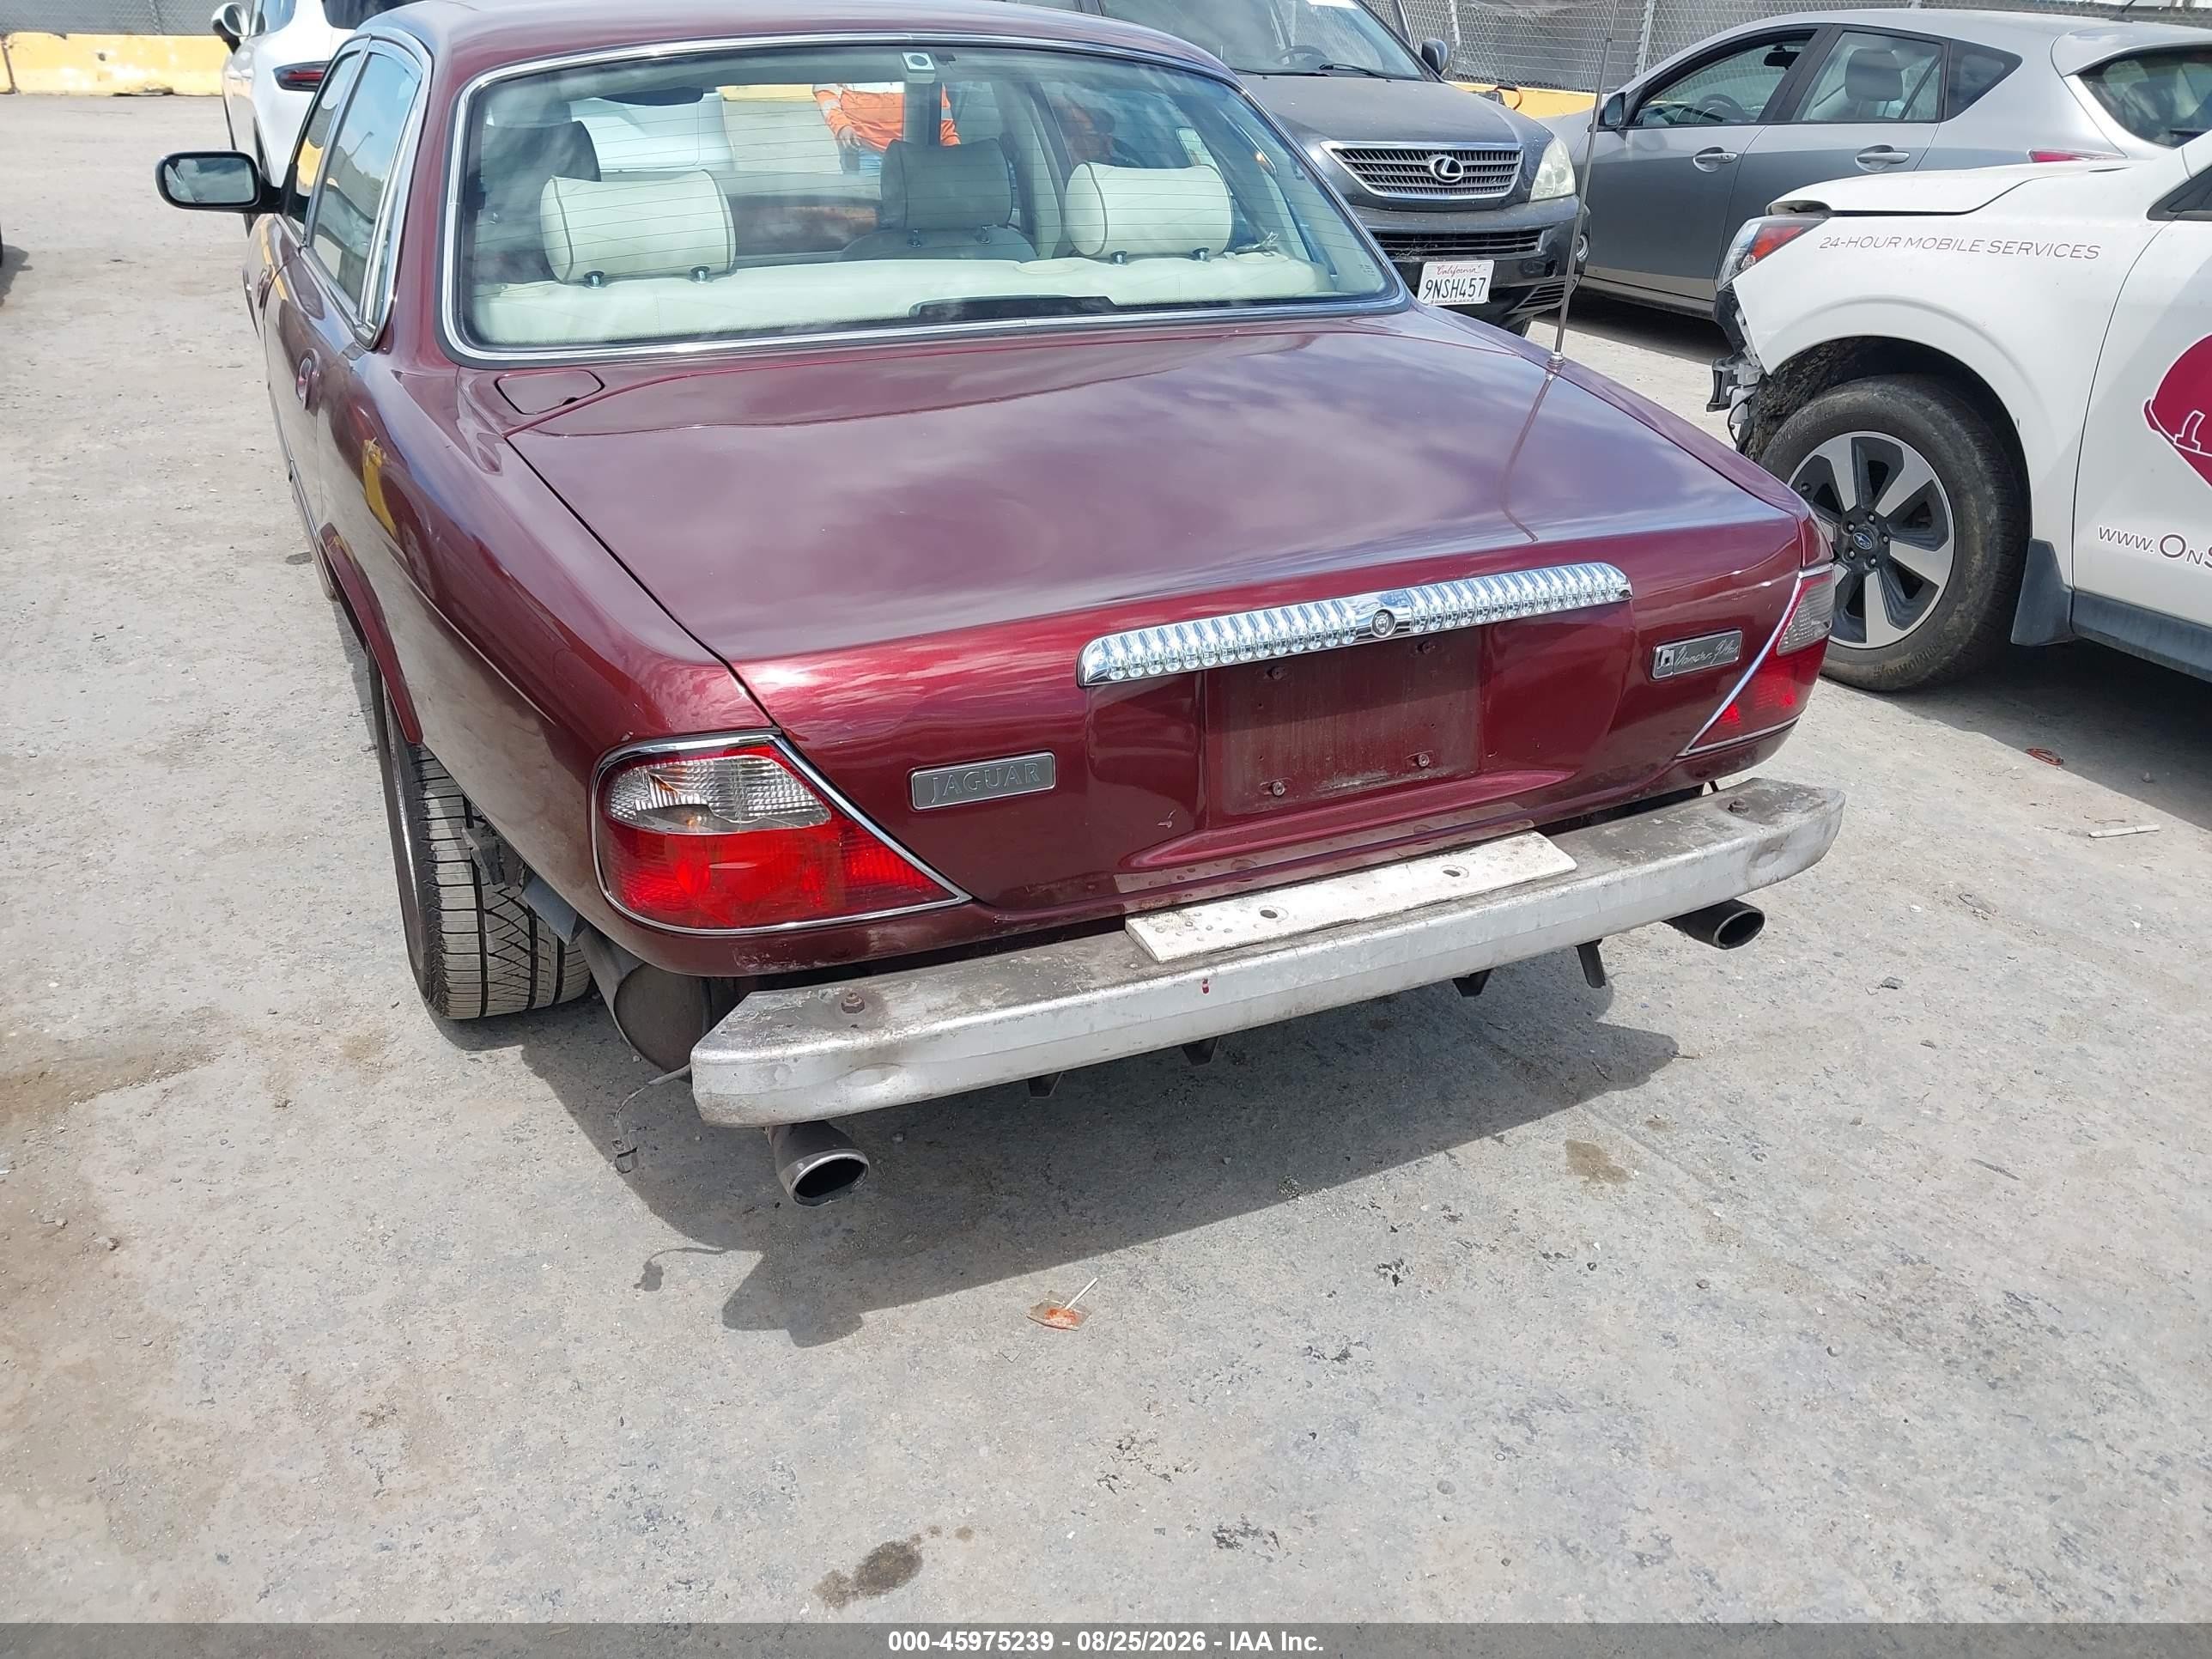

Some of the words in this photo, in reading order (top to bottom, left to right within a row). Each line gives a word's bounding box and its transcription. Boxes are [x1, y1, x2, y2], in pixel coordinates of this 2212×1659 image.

[1819, 236, 1901, 249] 24-HOUR
[1904, 237, 1985, 252] MOBILE
[1987, 240, 2101, 259] SERVICES
[1437, 264, 1480, 276] California
[1423, 277, 1486, 301] 9NSH457
[930, 763, 1041, 804] JAGUAR
